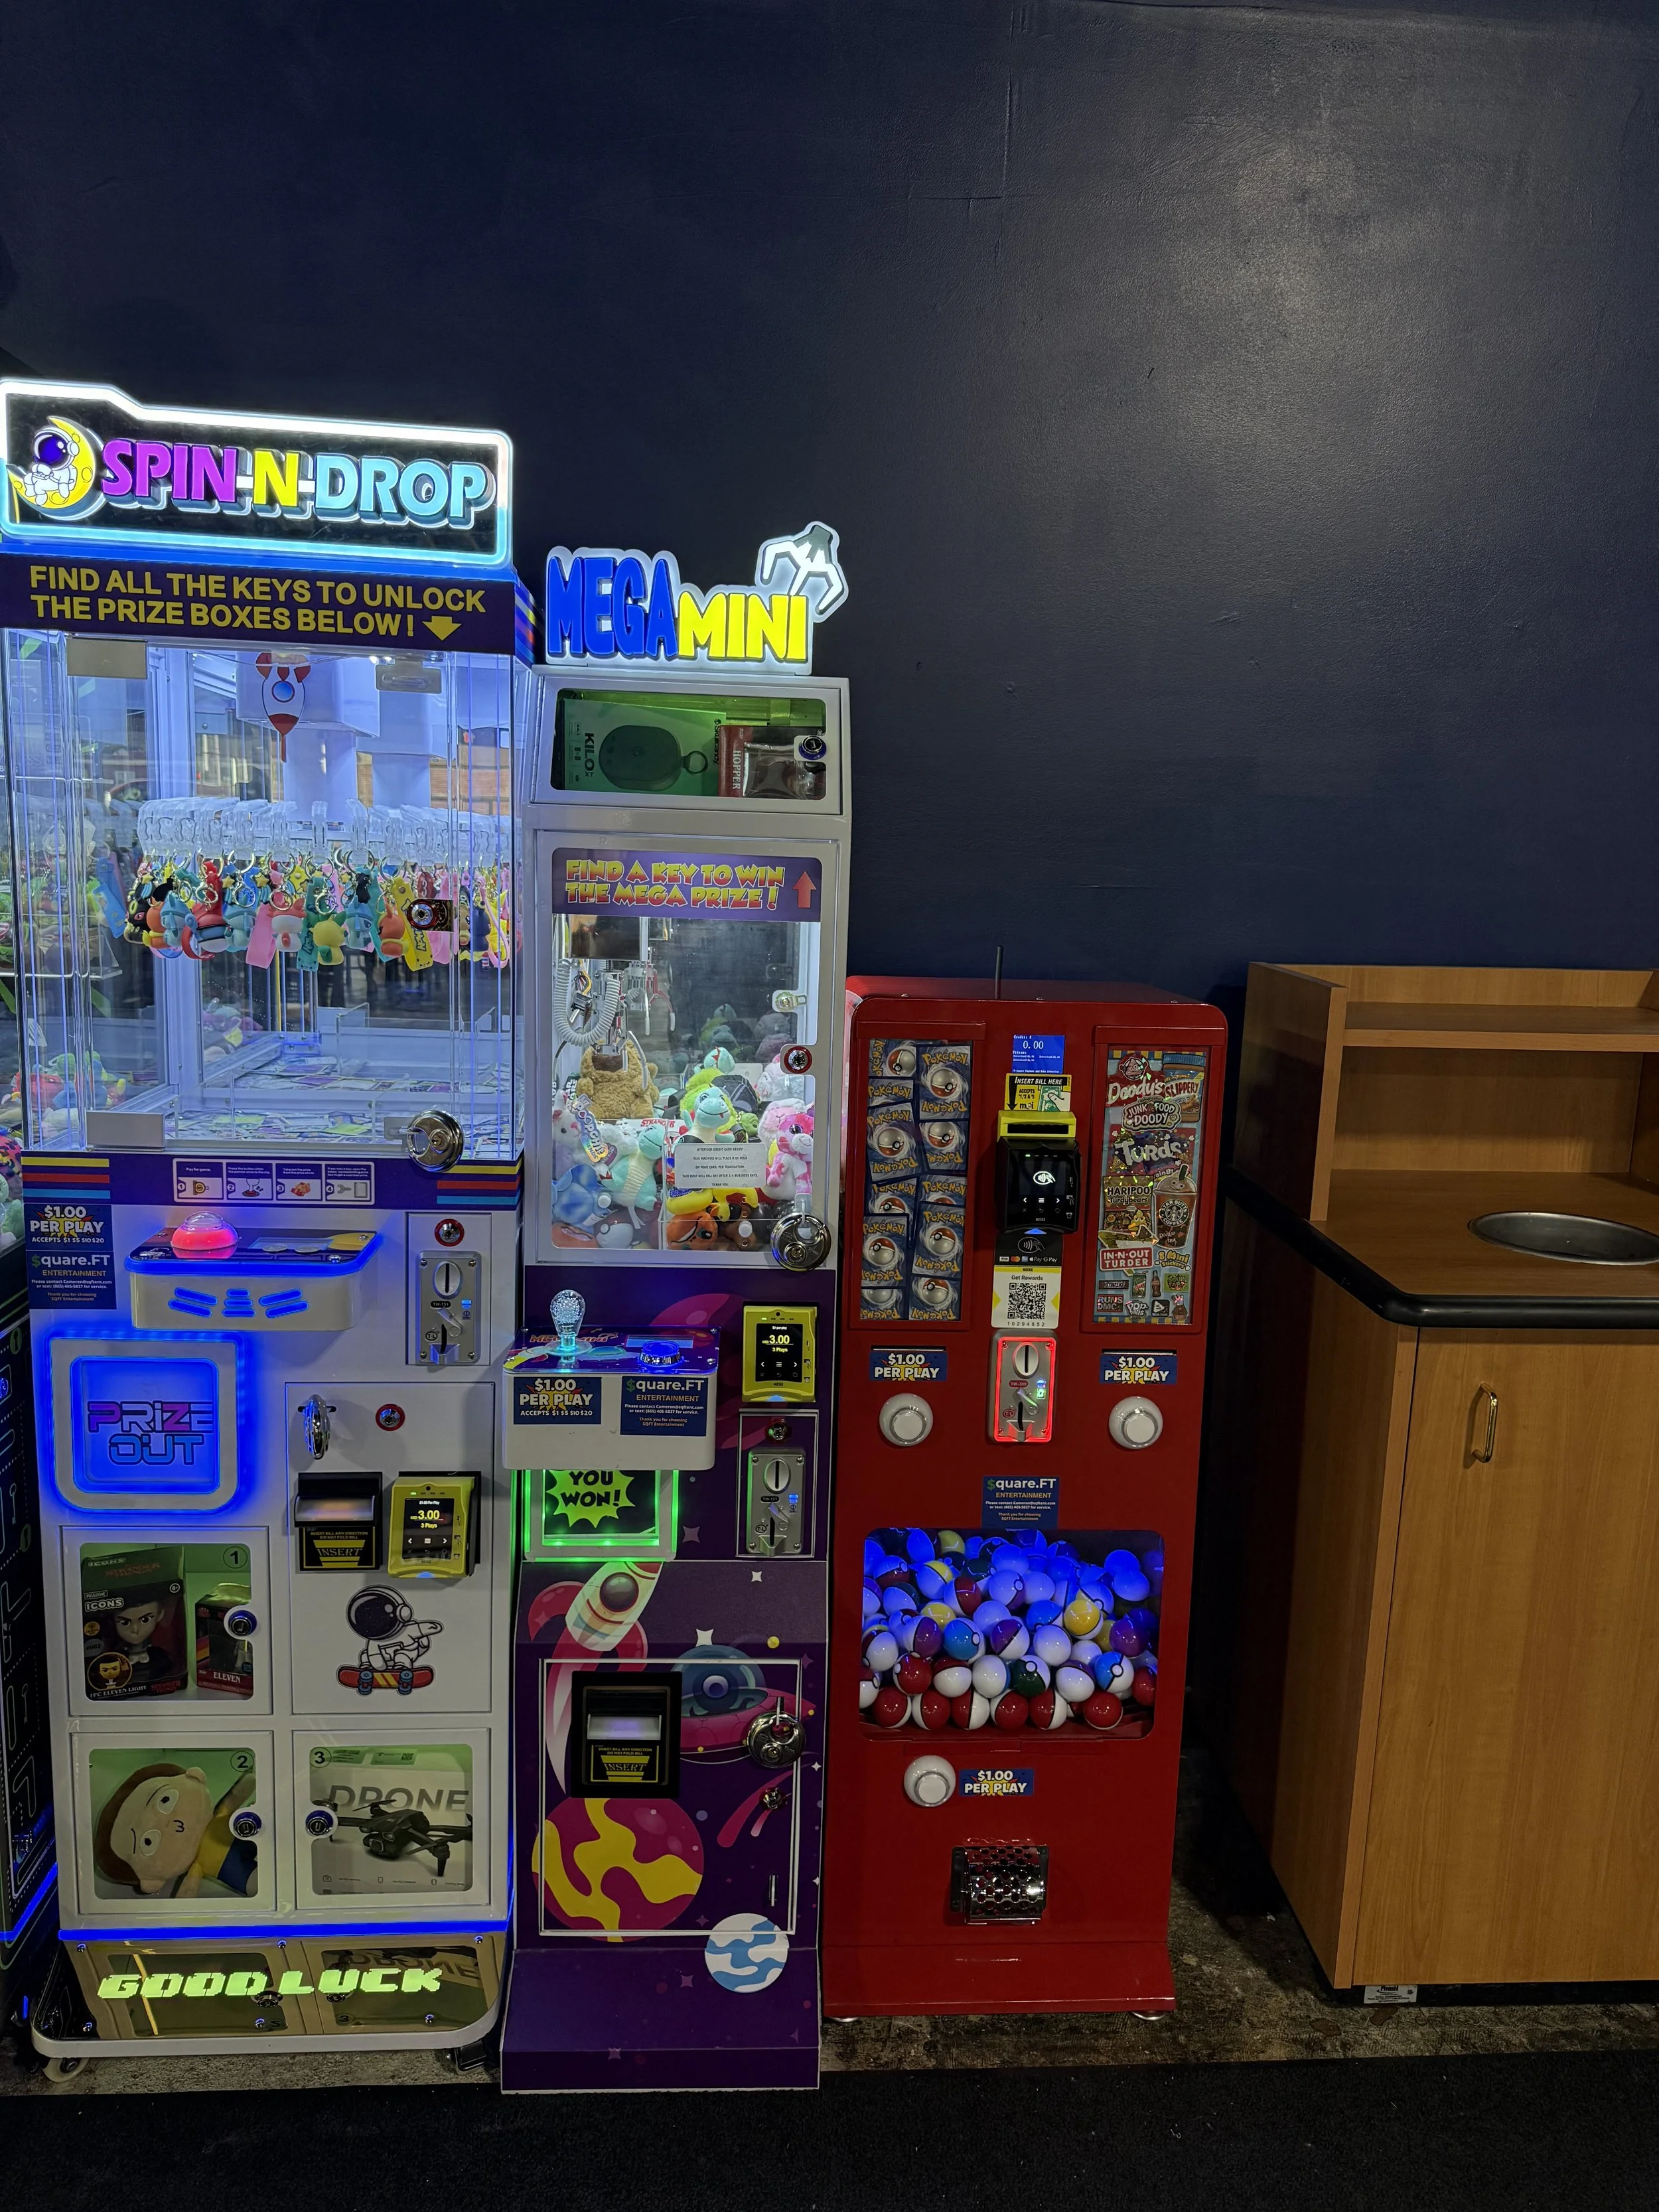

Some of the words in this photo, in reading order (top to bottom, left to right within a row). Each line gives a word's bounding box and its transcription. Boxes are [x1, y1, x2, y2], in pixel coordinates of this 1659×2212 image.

[31, 566, 100, 592] FIND
[106, 570, 162, 596] ALL
[166, 573, 228, 599] THE
[232, 577, 310, 605] KEYS
[315, 581, 358, 607] TO
[364, 584, 486, 615] UNLOCK
[31, 595, 92, 619] THE
[97, 598, 187, 625] PRIZE
[190, 603, 291, 630] BOXES
[547, 555, 678, 658] MEGA
[677, 591, 808, 660] MINI
[584, 733, 595, 770] KILO
[733, 749, 741, 790] HOPPER
[566, 859, 623, 883] FIND
[626, 861, 652, 884] A
[652, 862, 697, 886] KEY
[701, 863, 735, 887] TO
[735, 864, 785, 888] WIN
[566, 884, 611, 905] THE
[612, 885, 686, 907] MEGA
[1023, 1041, 1044, 1049] 0.00
[1107, 1076, 1166, 1105] Doody's
[1128, 1104, 1148, 1118] JUNK
[1155, 1102, 1175, 1113] FOOD
[1134, 1113, 1169, 1124] DOODY
[1107, 1186, 1150, 1196] HARIPOO
[44, 1205, 87, 1218] $1.00
[30, 1220, 60, 1232] PER
[64, 1220, 104, 1233] PLAY
[31, 1254, 111, 1268] $quare.FT
[1167, 1250, 1190, 1264] Mini
[1105, 1260, 1149, 1268] TURDER
[1161, 1260, 1187, 1270] Stickers
[769, 1335, 790, 1345] 3.00
[888, 1353, 925, 1366] $1.00
[1118, 1356, 1155, 1369] $1.00
[874, 1366, 902, 1379] PER
[904, 1366, 940, 1380] PLAY
[1104, 1370, 1132, 1382] PER
[1134, 1370, 1169, 1382] PLAY
[534, 1378, 577, 1391] $1.00
[626, 1379, 704, 1392] $quare.FT
[520, 1394, 548, 1406] PER
[553, 1394, 593, 1406] PLAY
[108, 1433, 204, 1465] OUT
[569, 1470, 614, 1487] YOU
[987, 1478, 1057, 1491] $quare.FT
[560, 1489, 622, 1508] WON!
[417, 1510, 441, 1520] 3.00
[230, 1550, 240, 1565] 1
[317, 1548, 363, 1557] INSERT
[85, 1598, 125, 1612] ICONS
[213, 1670, 242, 1684] ELEVEN
[103, 1688, 127, 1697] ELEVEN
[128, 1685, 147, 1694] LIGHT
[236, 1754, 249, 1768] 2
[314, 1751, 326, 1765] 3
[603, 1763, 647, 1771] INSERT
[977, 1769, 1014, 1782] $1.00
[964, 1783, 991, 1794] PER
[993, 1783, 1028, 1794] PLAY
[99, 1971, 268, 1999] GOOD
[277, 1966, 445, 1995] LUCK
